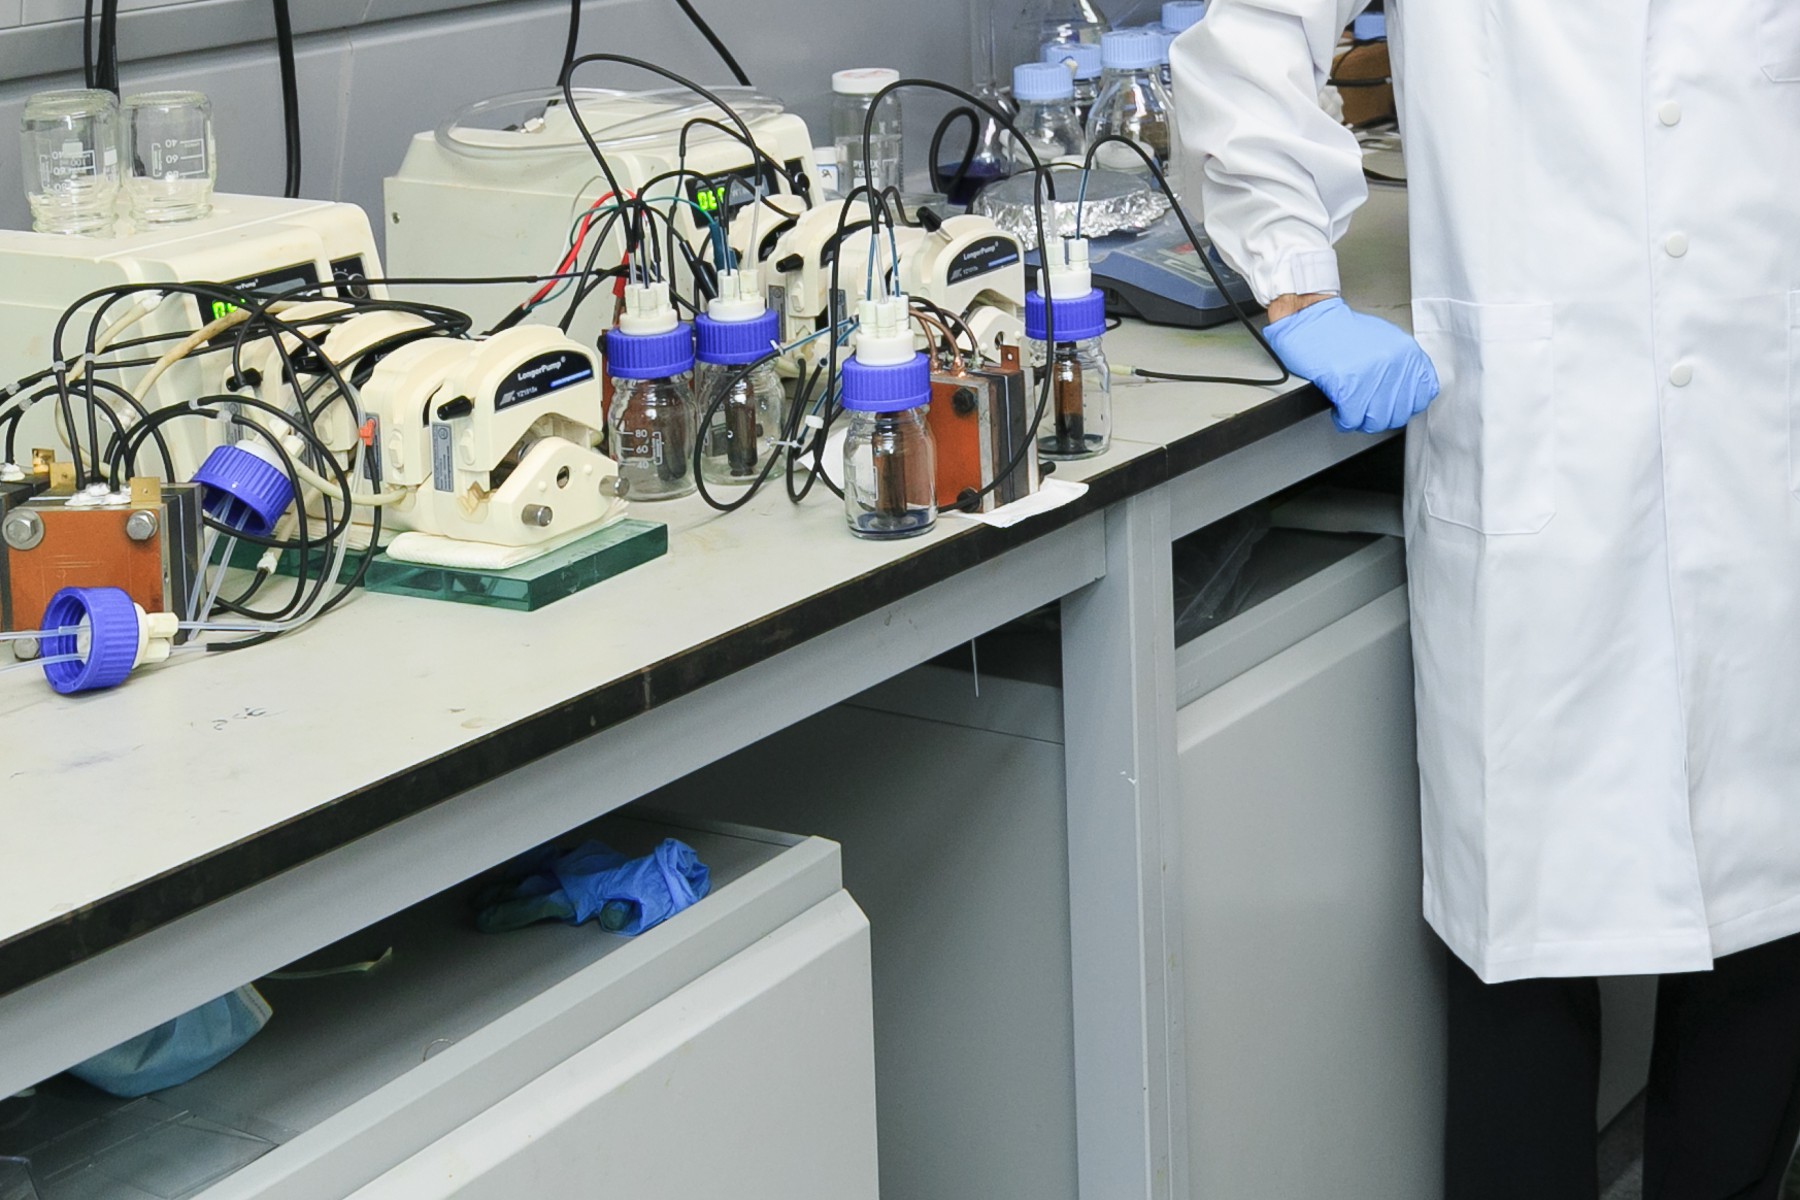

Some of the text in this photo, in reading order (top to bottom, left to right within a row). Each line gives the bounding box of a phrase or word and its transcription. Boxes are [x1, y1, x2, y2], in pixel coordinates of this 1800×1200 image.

[165, 154, 179, 163] 60
[517, 361, 562, 381] LongerPump
[635, 429, 648, 438] 80
[636, 445, 649, 454] 60
[637, 461, 650, 469] 40
